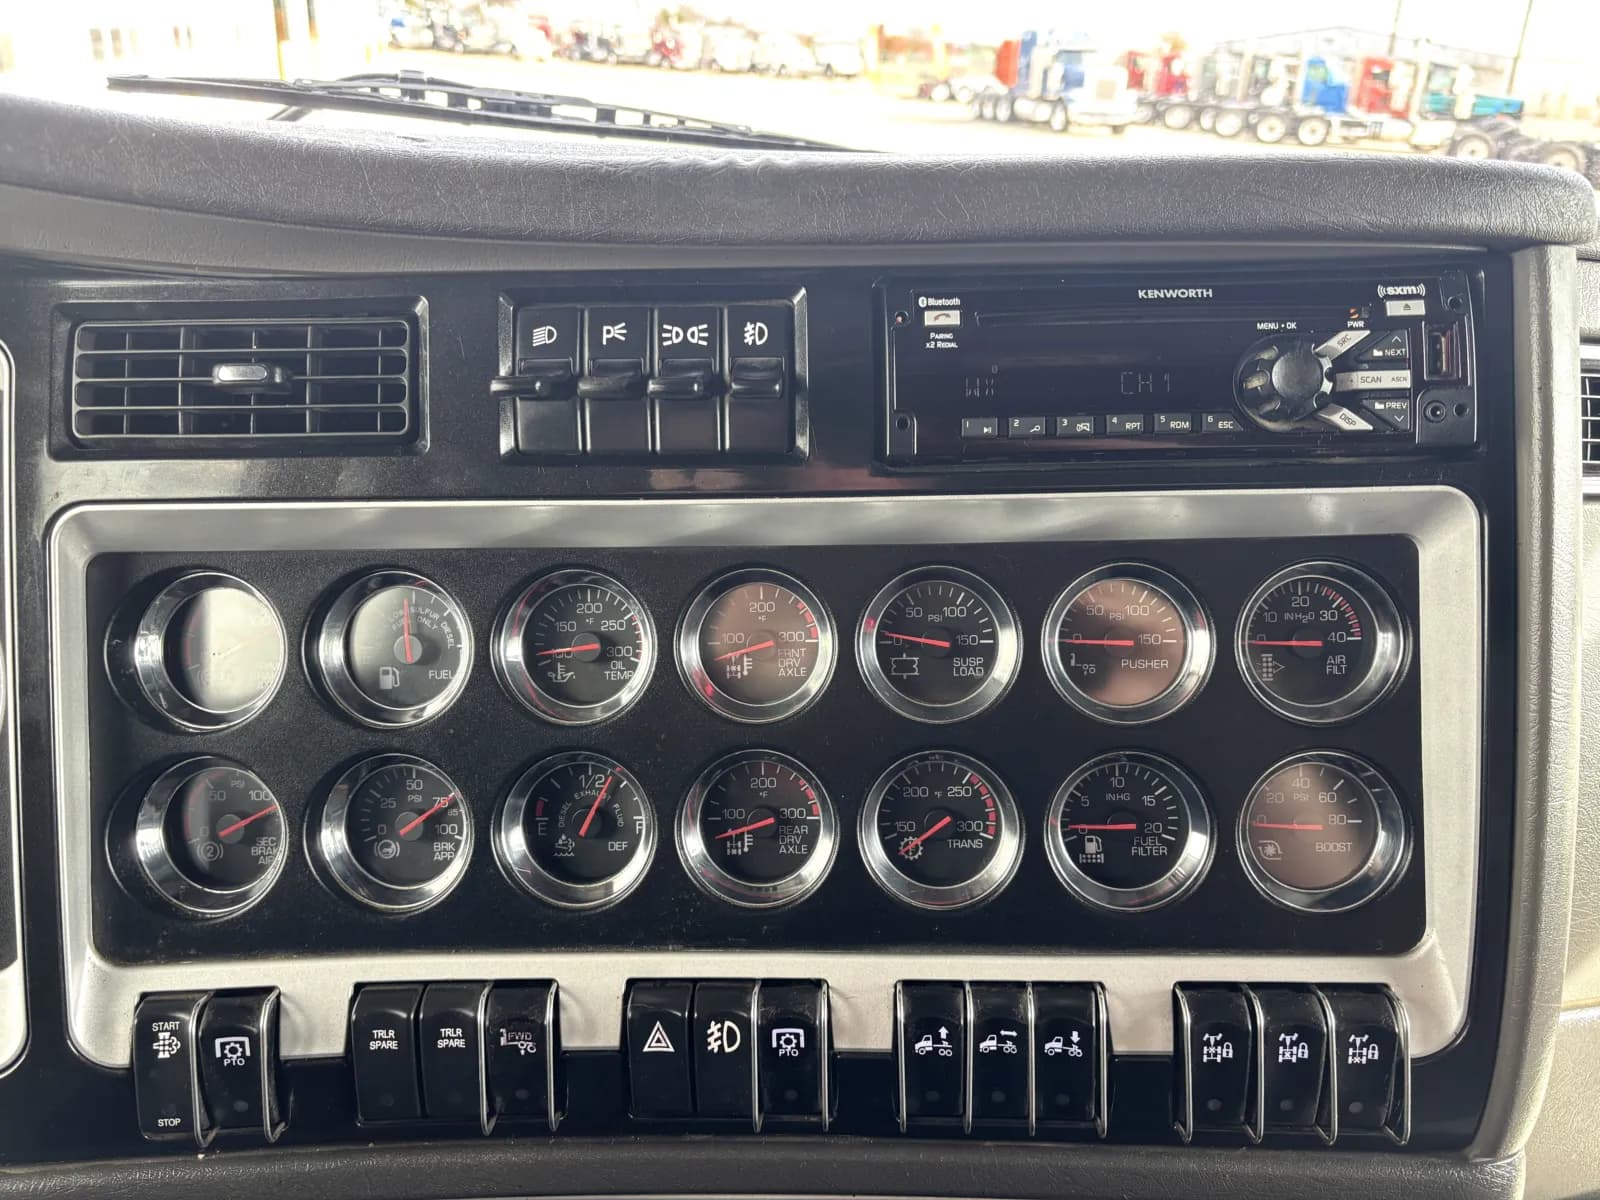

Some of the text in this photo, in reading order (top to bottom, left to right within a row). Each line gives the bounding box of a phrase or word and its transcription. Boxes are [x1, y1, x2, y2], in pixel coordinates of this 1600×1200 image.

[1137, 288, 1213, 299] KENWORTH
[927, 296, 961, 307] Bluetooth
[1257, 321, 1297, 330] MENU OK
[1347, 320, 1365, 329] PWR
[1336, 333, 1352, 348] SRC
[1384, 348, 1406, 357] NEXT
[1360, 375, 1382, 384] SCAN
[1385, 401, 1408, 410] PREV
[1013, 419, 1020, 427] 2
[1062, 418, 1068, 427] 3
[1111, 417, 1142, 431] 4 RPT
[1160, 415, 1190, 430] 5 RDM
[1207, 415, 1234, 429] 6 ESC
[1338, 411, 1357, 426] DISP
[749, 601, 776, 613] 200
[1291, 596, 1310, 608] 20
[576, 602, 603, 614] 200
[905, 606, 923, 618] 50
[942, 606, 967, 618] 100
[1085, 604, 1105, 616] 50
[1124, 604, 1150, 616] 100
[927, 614, 943, 623] PSI
[1109, 612, 1125, 621] PSI
[1262, 611, 1278, 623] 10
[1319, 610, 1338, 622] 30
[555, 620, 577, 632] 150
[600, 619, 626, 631] 250
[721, 632, 745, 644] 100
[778, 631, 805, 642] 300
[955, 634, 979, 646] 150
[1137, 634, 1162, 645] 150
[1327, 631, 1347, 643] 40
[606, 646, 633, 657] 300
[777, 648, 807, 658] FRNT
[610, 660, 626, 671] OIL
[778, 658, 801, 668] DRV
[952, 656, 984, 668] SUSP
[1121, 658, 1169, 669] PUSHER
[1326, 655, 1347, 665] AIR
[428, 669, 455, 680] FUEL
[778, 667, 808, 677] AXLE
[953, 667, 984, 677] LOAD
[1326, 664, 1348, 675] FILT
[604, 670, 634, 681] TEMP
[230, 780, 245, 789] PSI
[405, 779, 424, 791] 50
[578, 774, 605, 789] 1/2
[750, 777, 777, 789] 200
[1109, 776, 1125, 788] 10
[1291, 777, 1311, 789] 40
[208, 790, 226, 801] 50
[248, 790, 273, 801] 100
[902, 786, 929, 798] 200
[947, 785, 972, 797] 250
[1293, 792, 1309, 801] PSI
[407, 794, 422, 803] PSI
[431, 796, 449, 808] 75
[1080, 795, 1090, 807] 5
[1142, 795, 1157, 807] 15
[1265, 792, 1285, 804] 20
[1318, 791, 1337, 803] 60
[380, 798, 397, 809] 25
[612, 803, 625, 828] FLUID
[721, 808, 745, 820] 100
[779, 807, 807, 819] 300
[1328, 813, 1347, 825] 80
[377, 824, 387, 835] 0
[434, 824, 458, 835] 100
[537, 821, 547, 836] E
[778, 825, 808, 835] REAR
[895, 820, 916, 832] 150
[956, 820, 984, 832] 300
[1078, 824, 1088, 835] 0
[1143, 822, 1163, 834] 20
[255, 837, 277, 847] SEC
[778, 835, 802, 844] DRV
[946, 839, 984, 849] TRANS
[1133, 836, 1163, 846] FUEL
[433, 841, 455, 852] BRK
[608, 841, 629, 851] DEF
[778, 844, 808, 855] AXLE
[1131, 846, 1168, 857] FILTER
[1315, 841, 1353, 853] BOOST
[257, 855, 275, 865] AIR
[433, 851, 455, 861] APP
[151, 1021, 181, 1032] START
[372, 1029, 395, 1040] TRLR
[439, 1028, 463, 1038] TRLR
[507, 1031, 533, 1041] FWD
[369, 1040, 399, 1050] SPARE
[437, 1039, 466, 1049] SPARE
[777, 1048, 799, 1057] PTO
[223, 1057, 246, 1067] PTO
[157, 1118, 181, 1128] STOP
